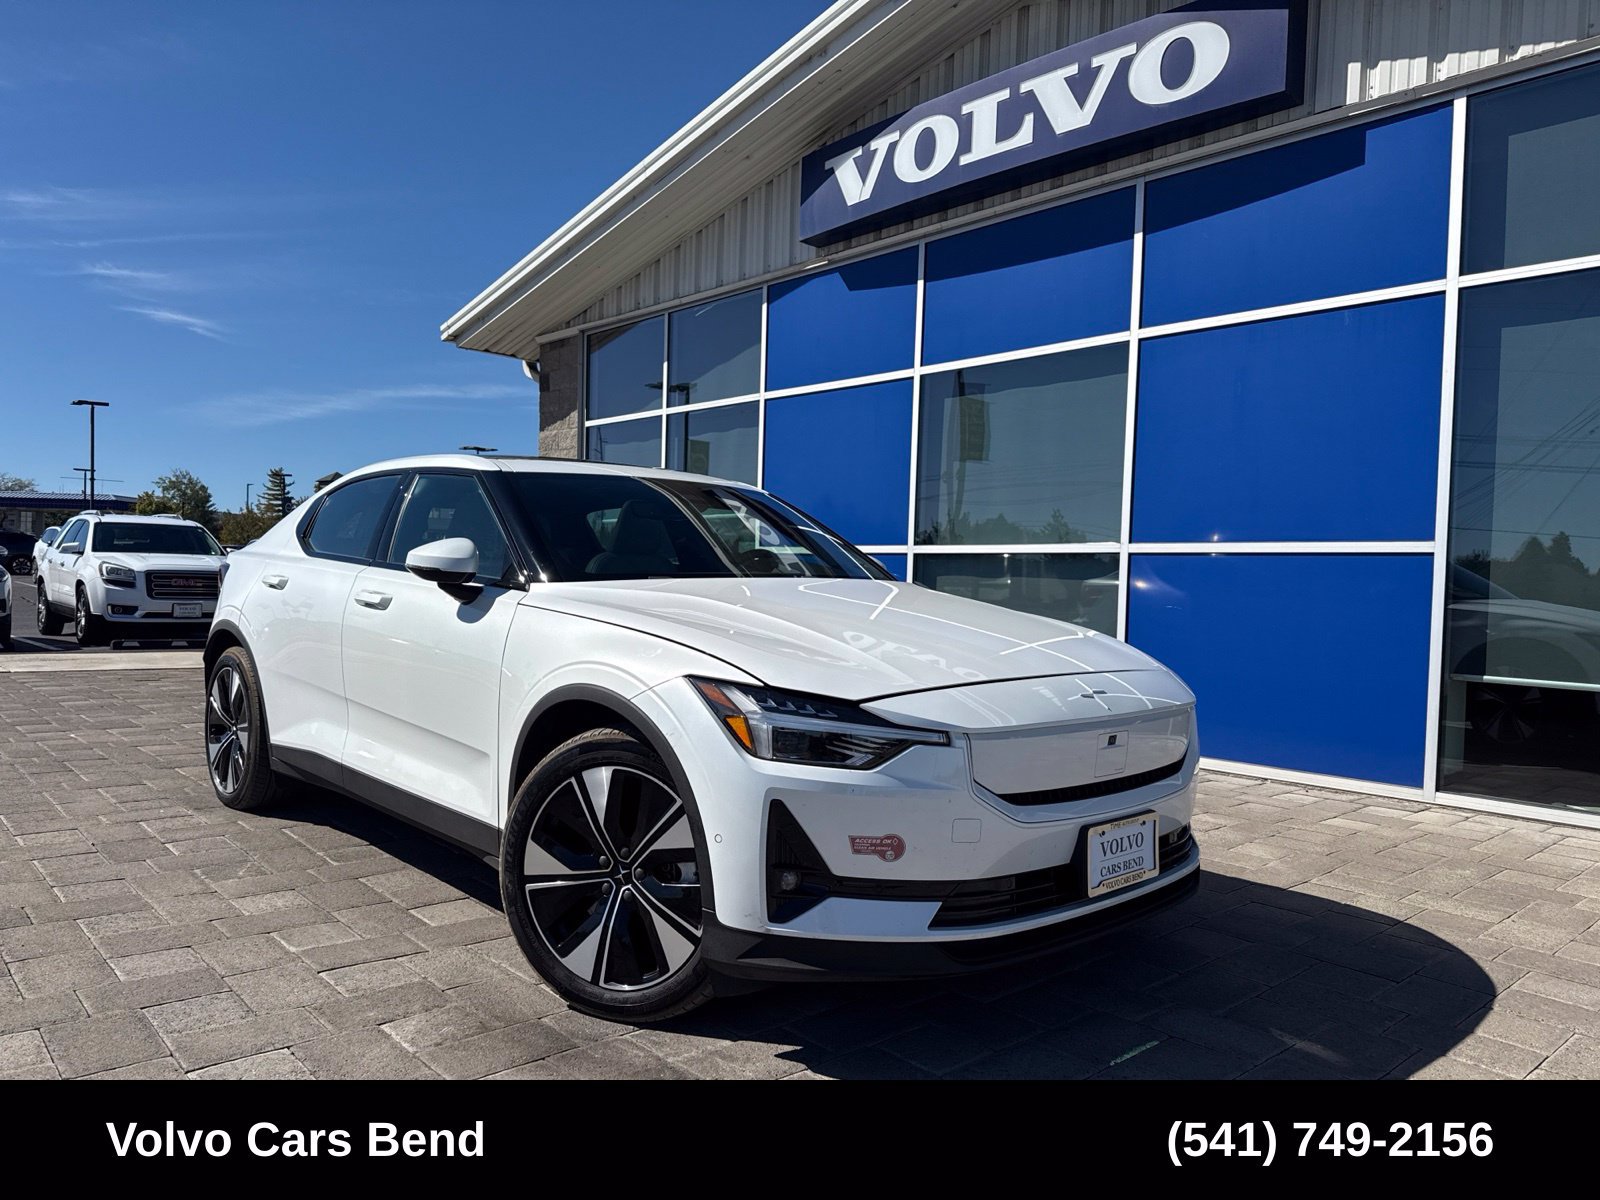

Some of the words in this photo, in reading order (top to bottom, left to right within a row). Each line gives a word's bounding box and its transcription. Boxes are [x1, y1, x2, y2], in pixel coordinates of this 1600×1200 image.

[824, 21, 1230, 207] VOLVO
[1100, 832, 1144, 857] VOLVO
[1100, 862, 1121, 878] CARS
[1122, 856, 1144, 871] BEND
[1105, 878, 1120, 890] VOLVO
[1120, 875, 1132, 885] CARS
[1132, 872, 1144, 882] BEND
